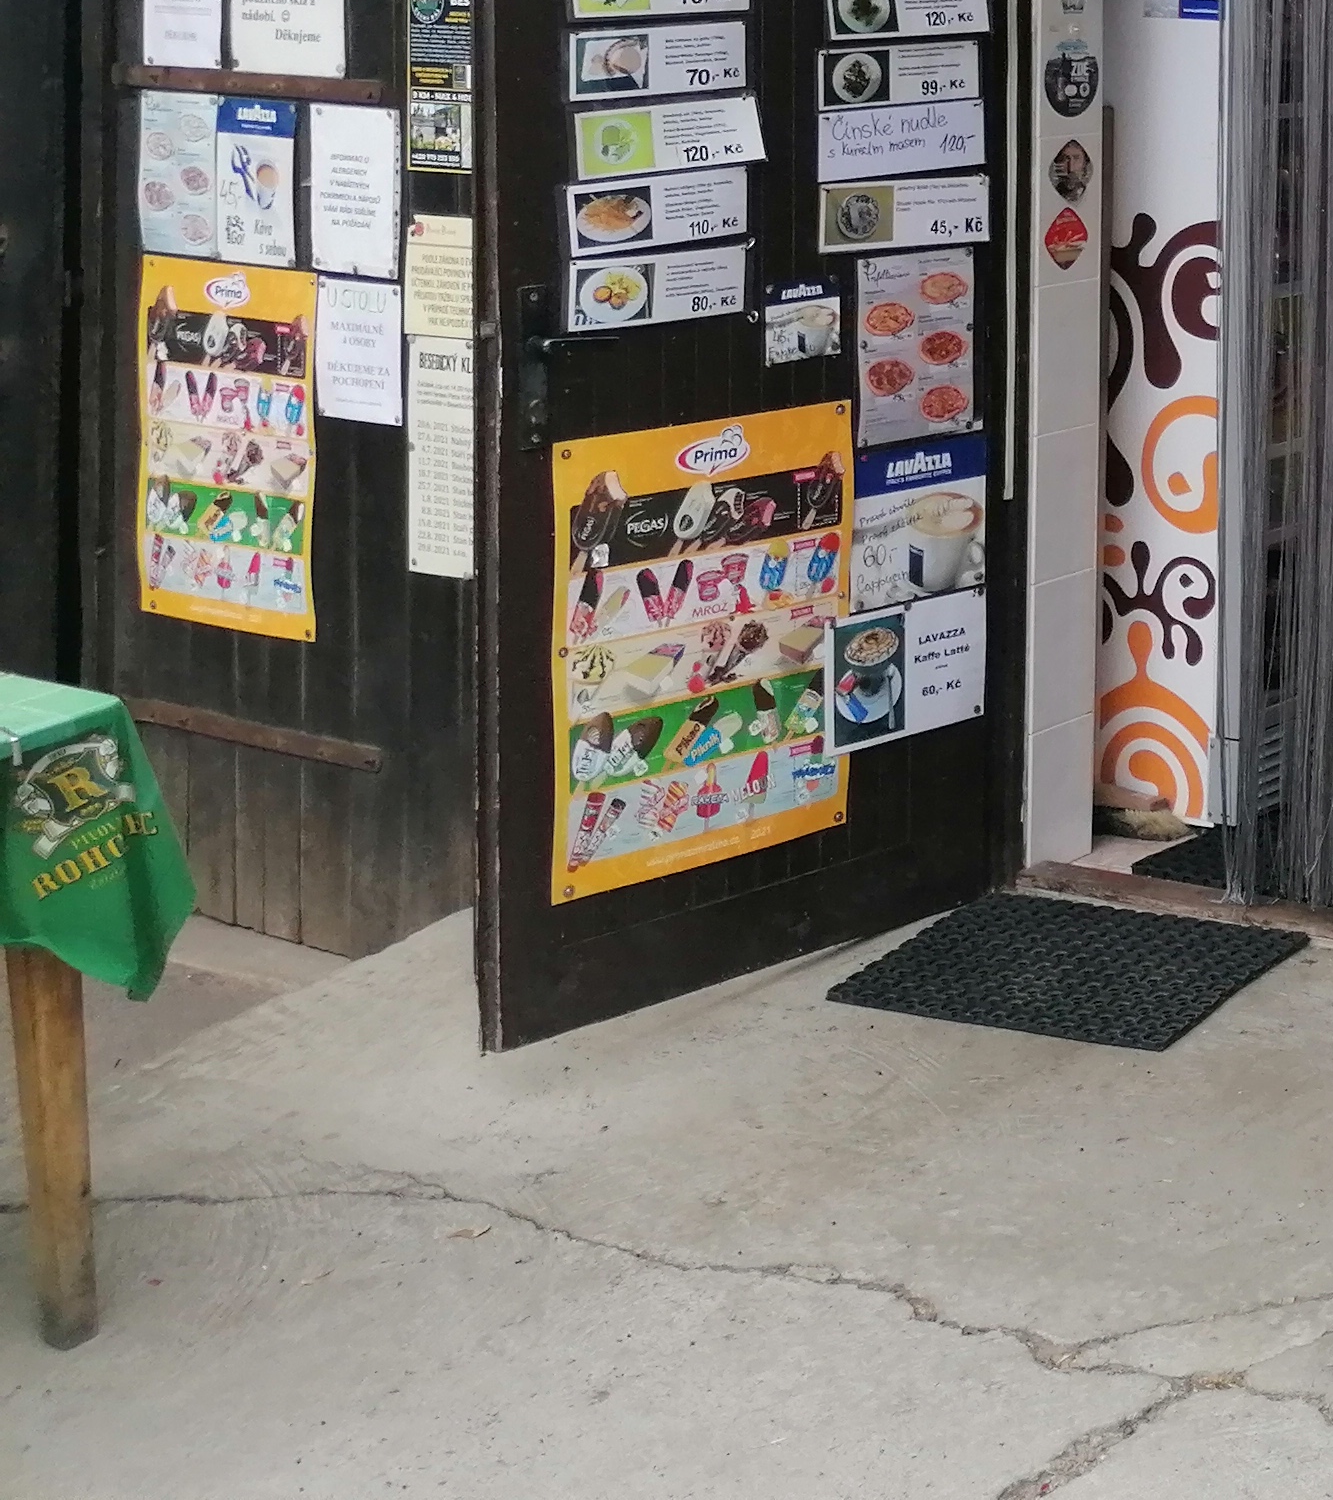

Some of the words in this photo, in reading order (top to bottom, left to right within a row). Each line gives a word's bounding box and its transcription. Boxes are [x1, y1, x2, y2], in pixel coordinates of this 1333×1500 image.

[275, 29, 321, 45] Děkujeme
[949, 78, 965, 91] Kč
[831, 114, 894, 142] Čínské
[901, 104, 948, 131] nudle
[724, 143, 744, 155] Kč
[215, 286, 243, 300] Prima
[781, 283, 824, 300] LAVAZZA
[693, 445, 738, 464] Prima
[886, 452, 952, 480] LAVAZZA
[627, 518, 665, 536] PEGAS
[692, 602, 729, 618] MROZ
[917, 627, 967, 646] LAVAZZA
[914, 650, 941, 665] Kaffe
